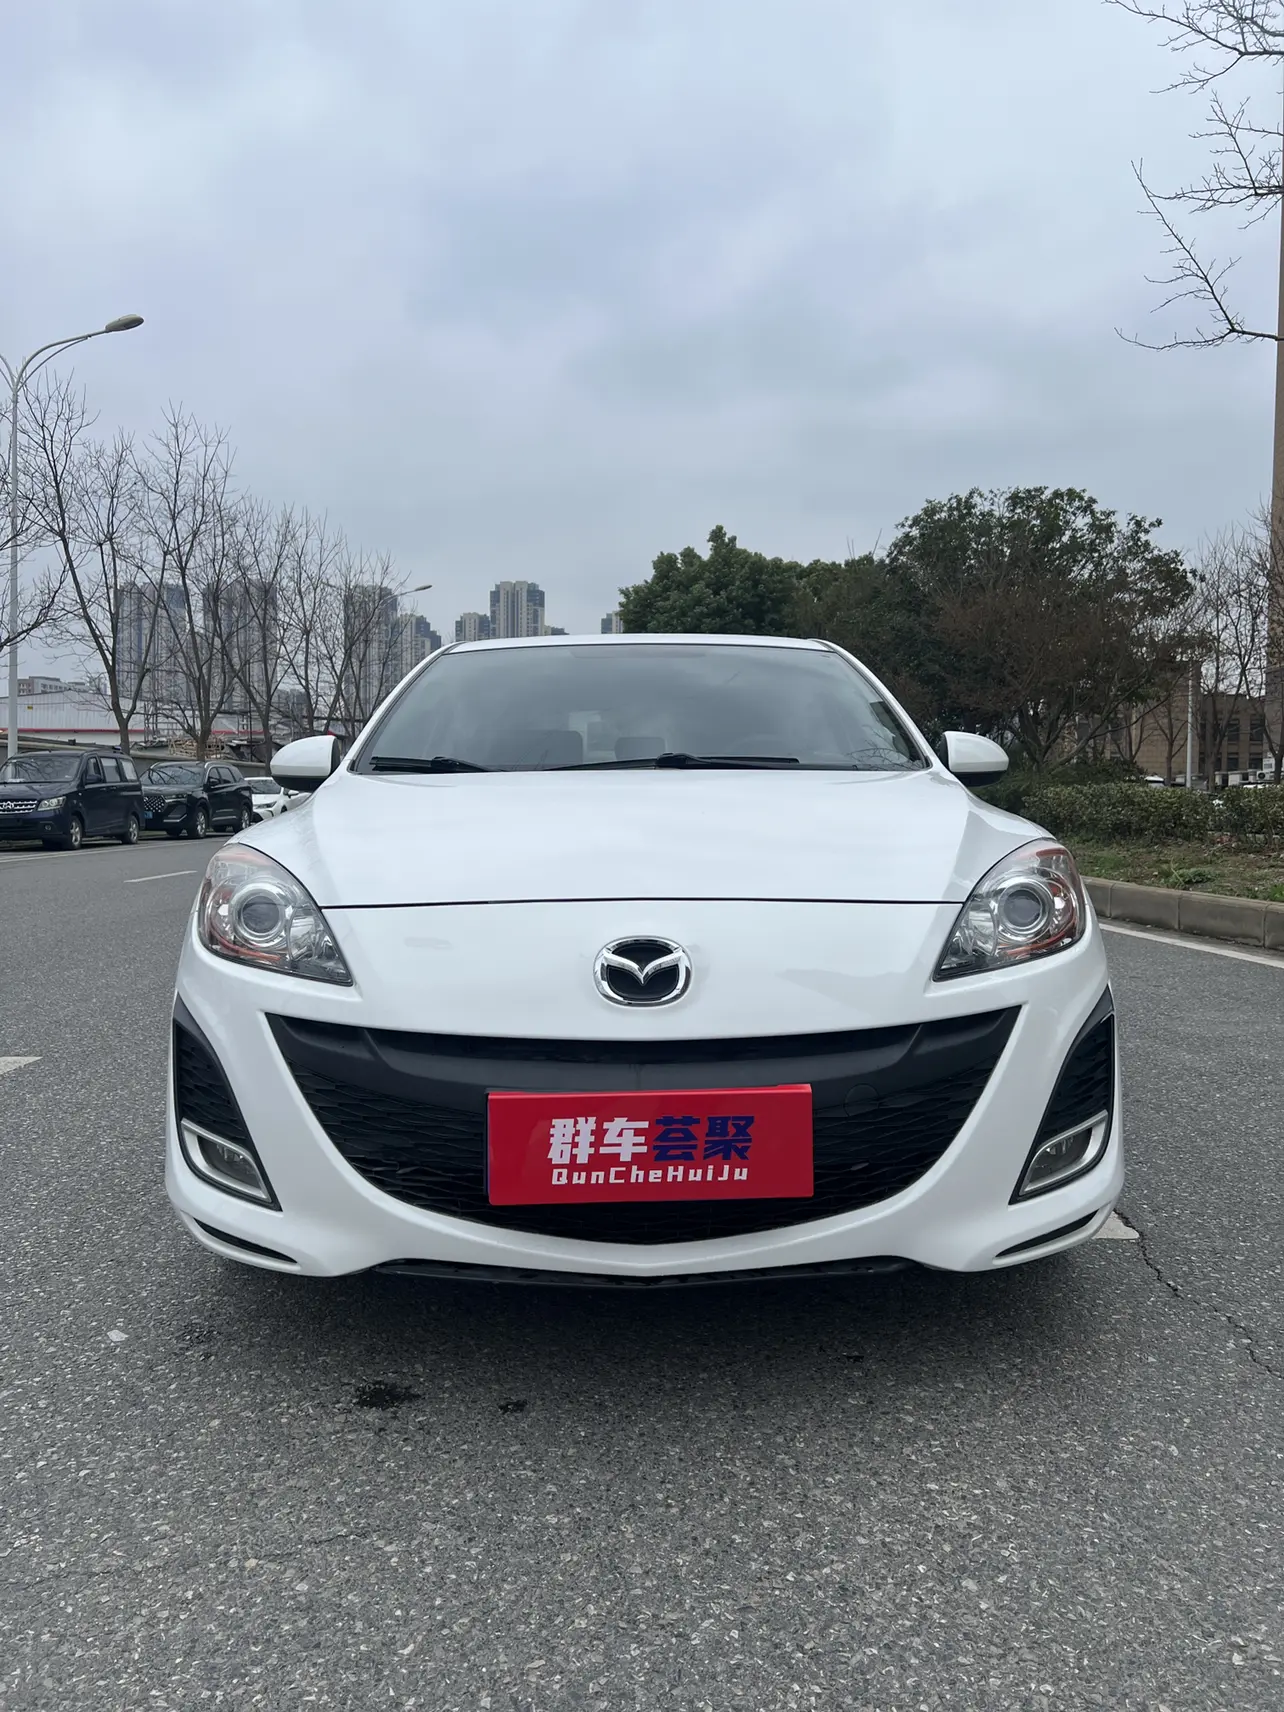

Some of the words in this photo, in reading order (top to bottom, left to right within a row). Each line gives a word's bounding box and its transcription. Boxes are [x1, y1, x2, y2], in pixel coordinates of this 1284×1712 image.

[547, 1115, 755, 1164] 群车荟聚
[551, 1164, 748, 1185] QunCheHuiJu
